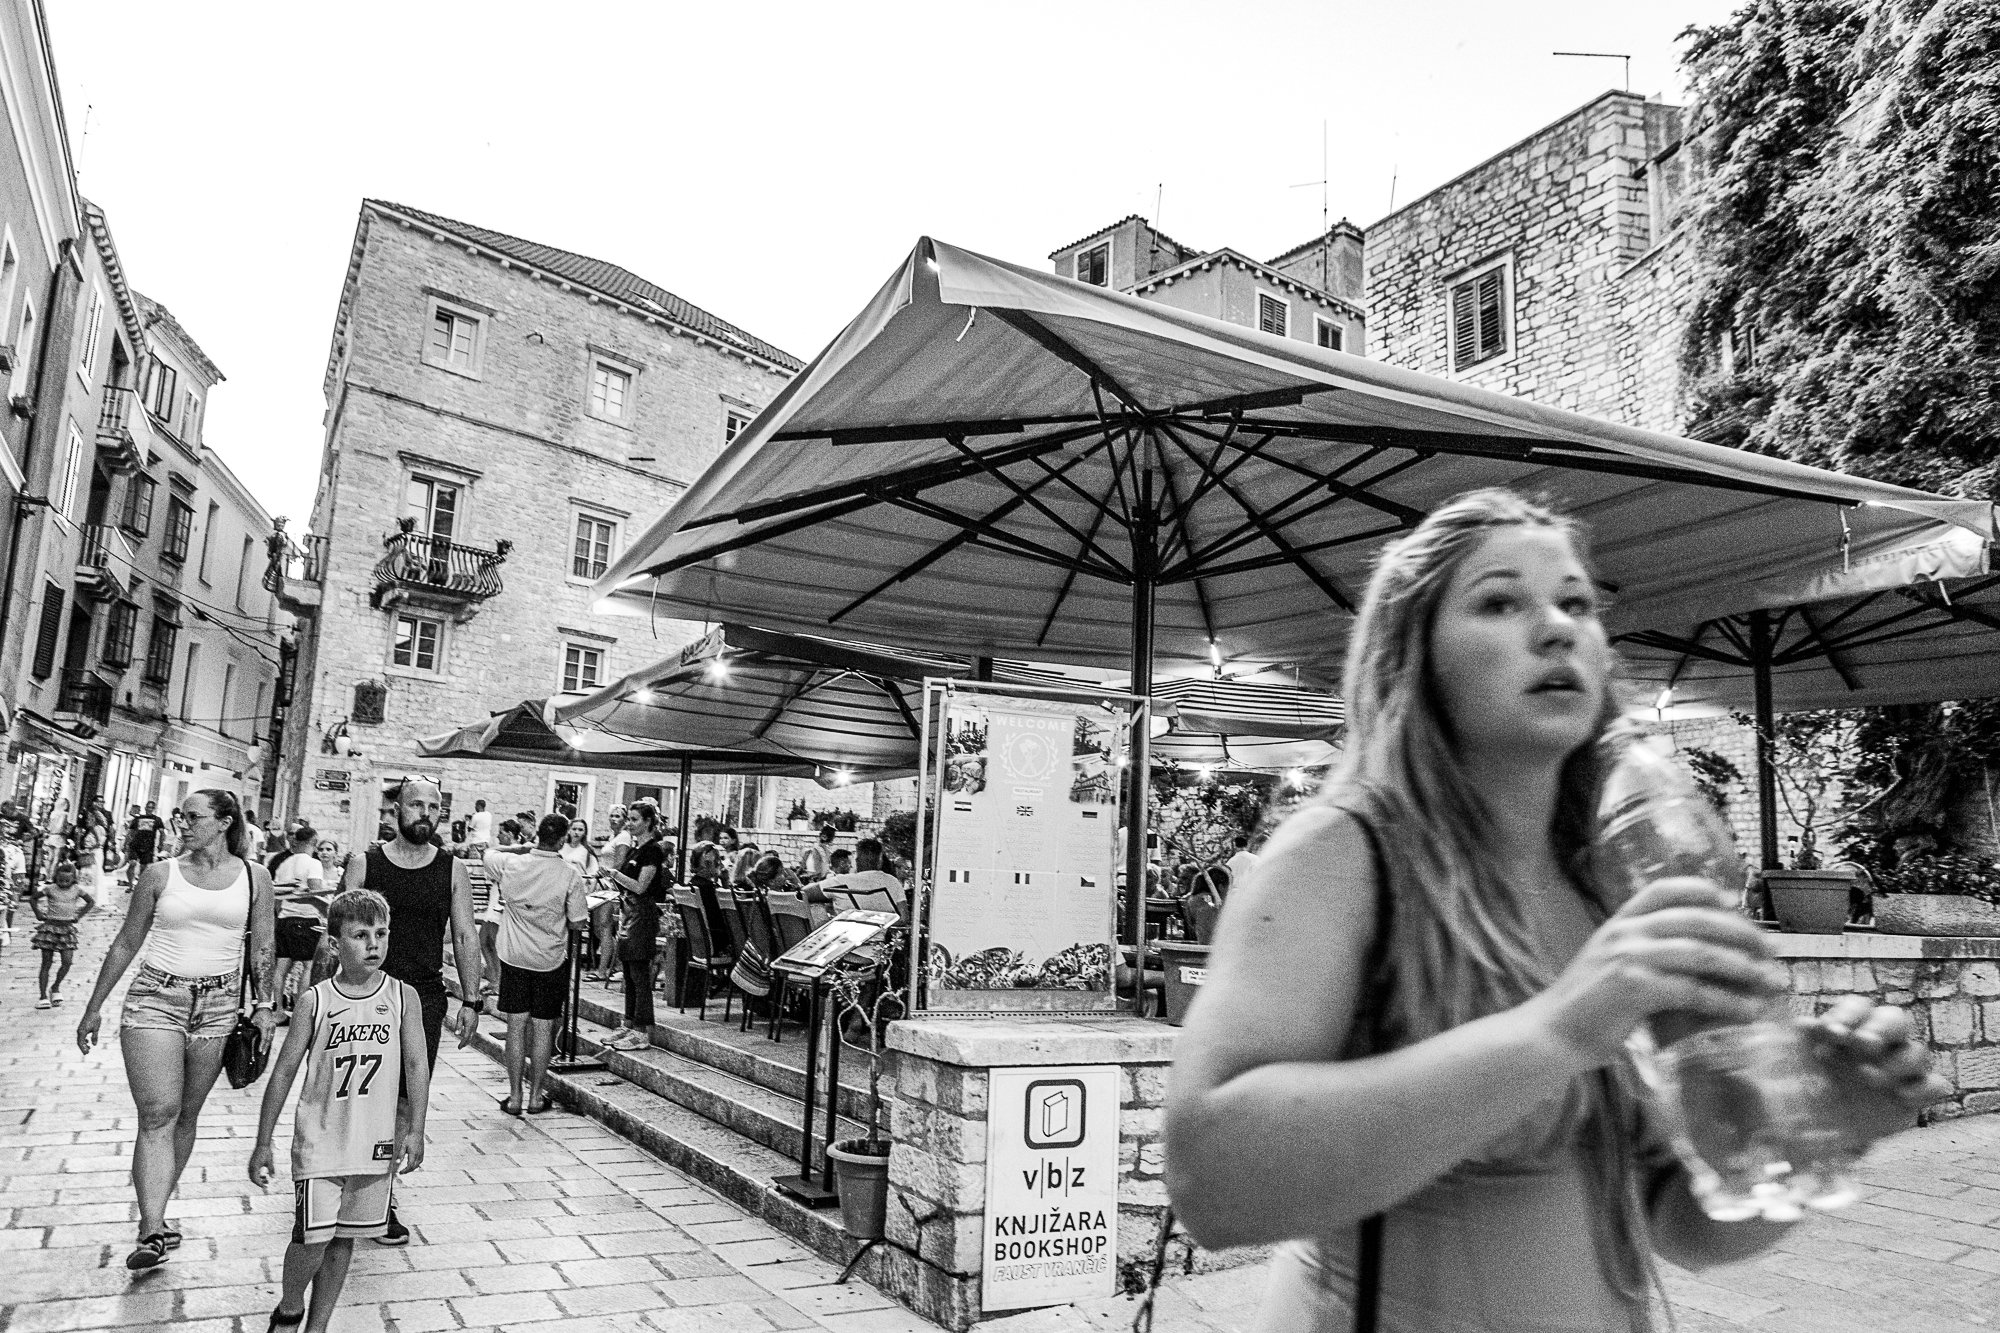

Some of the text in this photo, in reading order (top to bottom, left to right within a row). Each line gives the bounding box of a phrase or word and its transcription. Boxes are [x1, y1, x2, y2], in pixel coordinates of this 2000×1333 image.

[996, 715, 1068, 732] WELCOME
[324, 1022, 391, 1051] LAKERS
[334, 1054, 383, 1099] 77
[995, 1207, 1107, 1237] KNJIŽARA
[995, 1235, 1107, 1261] BOOKSHOP
[993, 1263, 1042, 1282] FAUST
